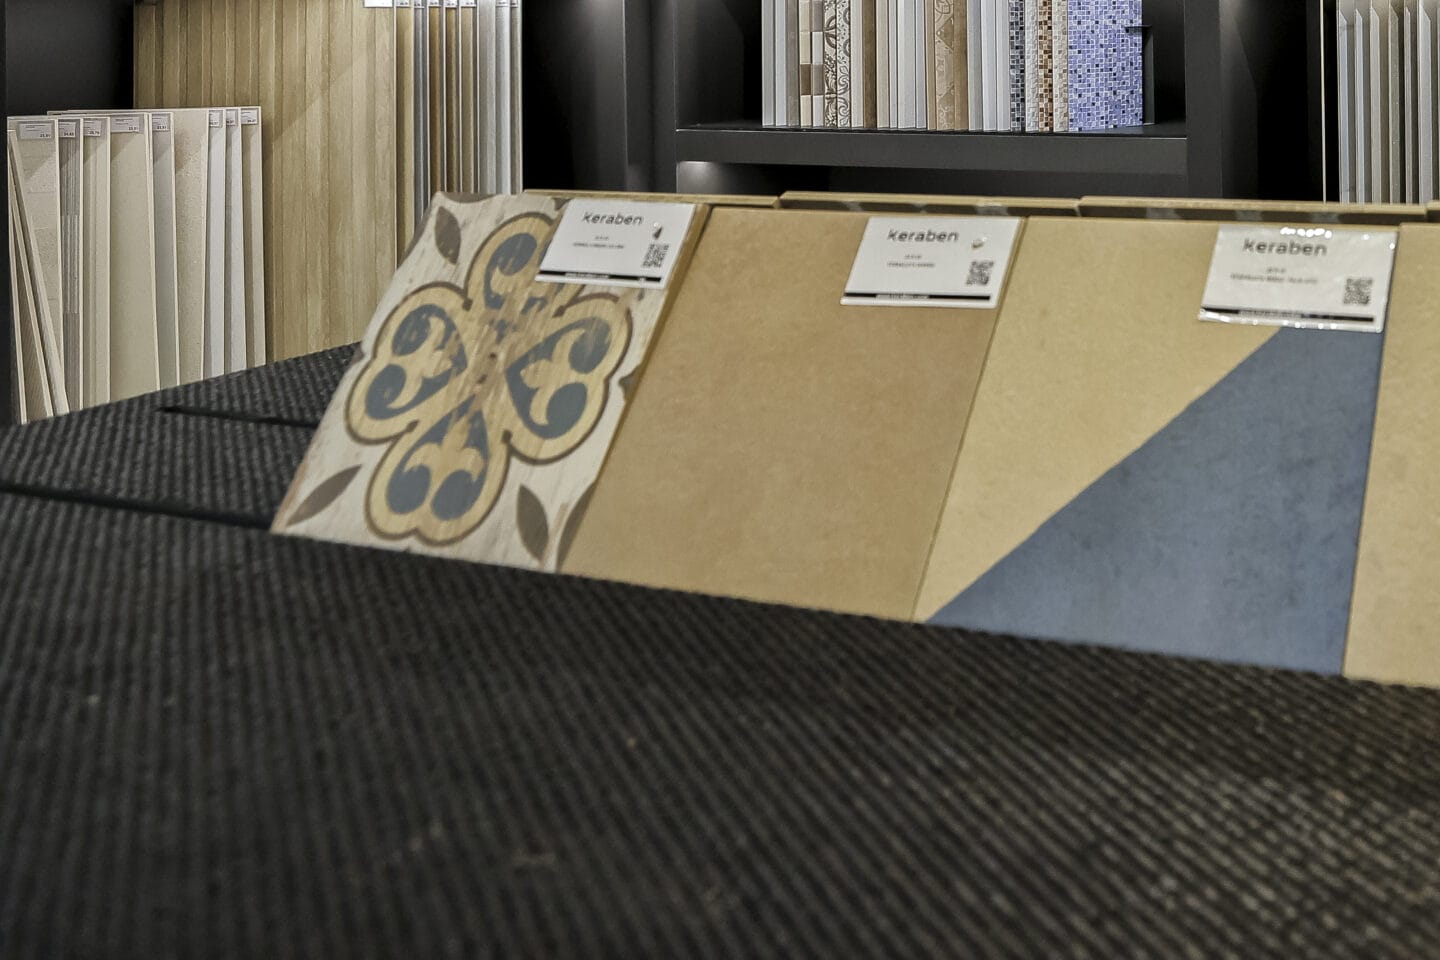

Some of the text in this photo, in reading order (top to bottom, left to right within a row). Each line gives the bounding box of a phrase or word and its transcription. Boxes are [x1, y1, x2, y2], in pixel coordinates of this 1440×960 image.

[582, 211, 643, 226] keraben
[886, 229, 959, 243] keraben
[1243, 238, 1327, 257] keraben
